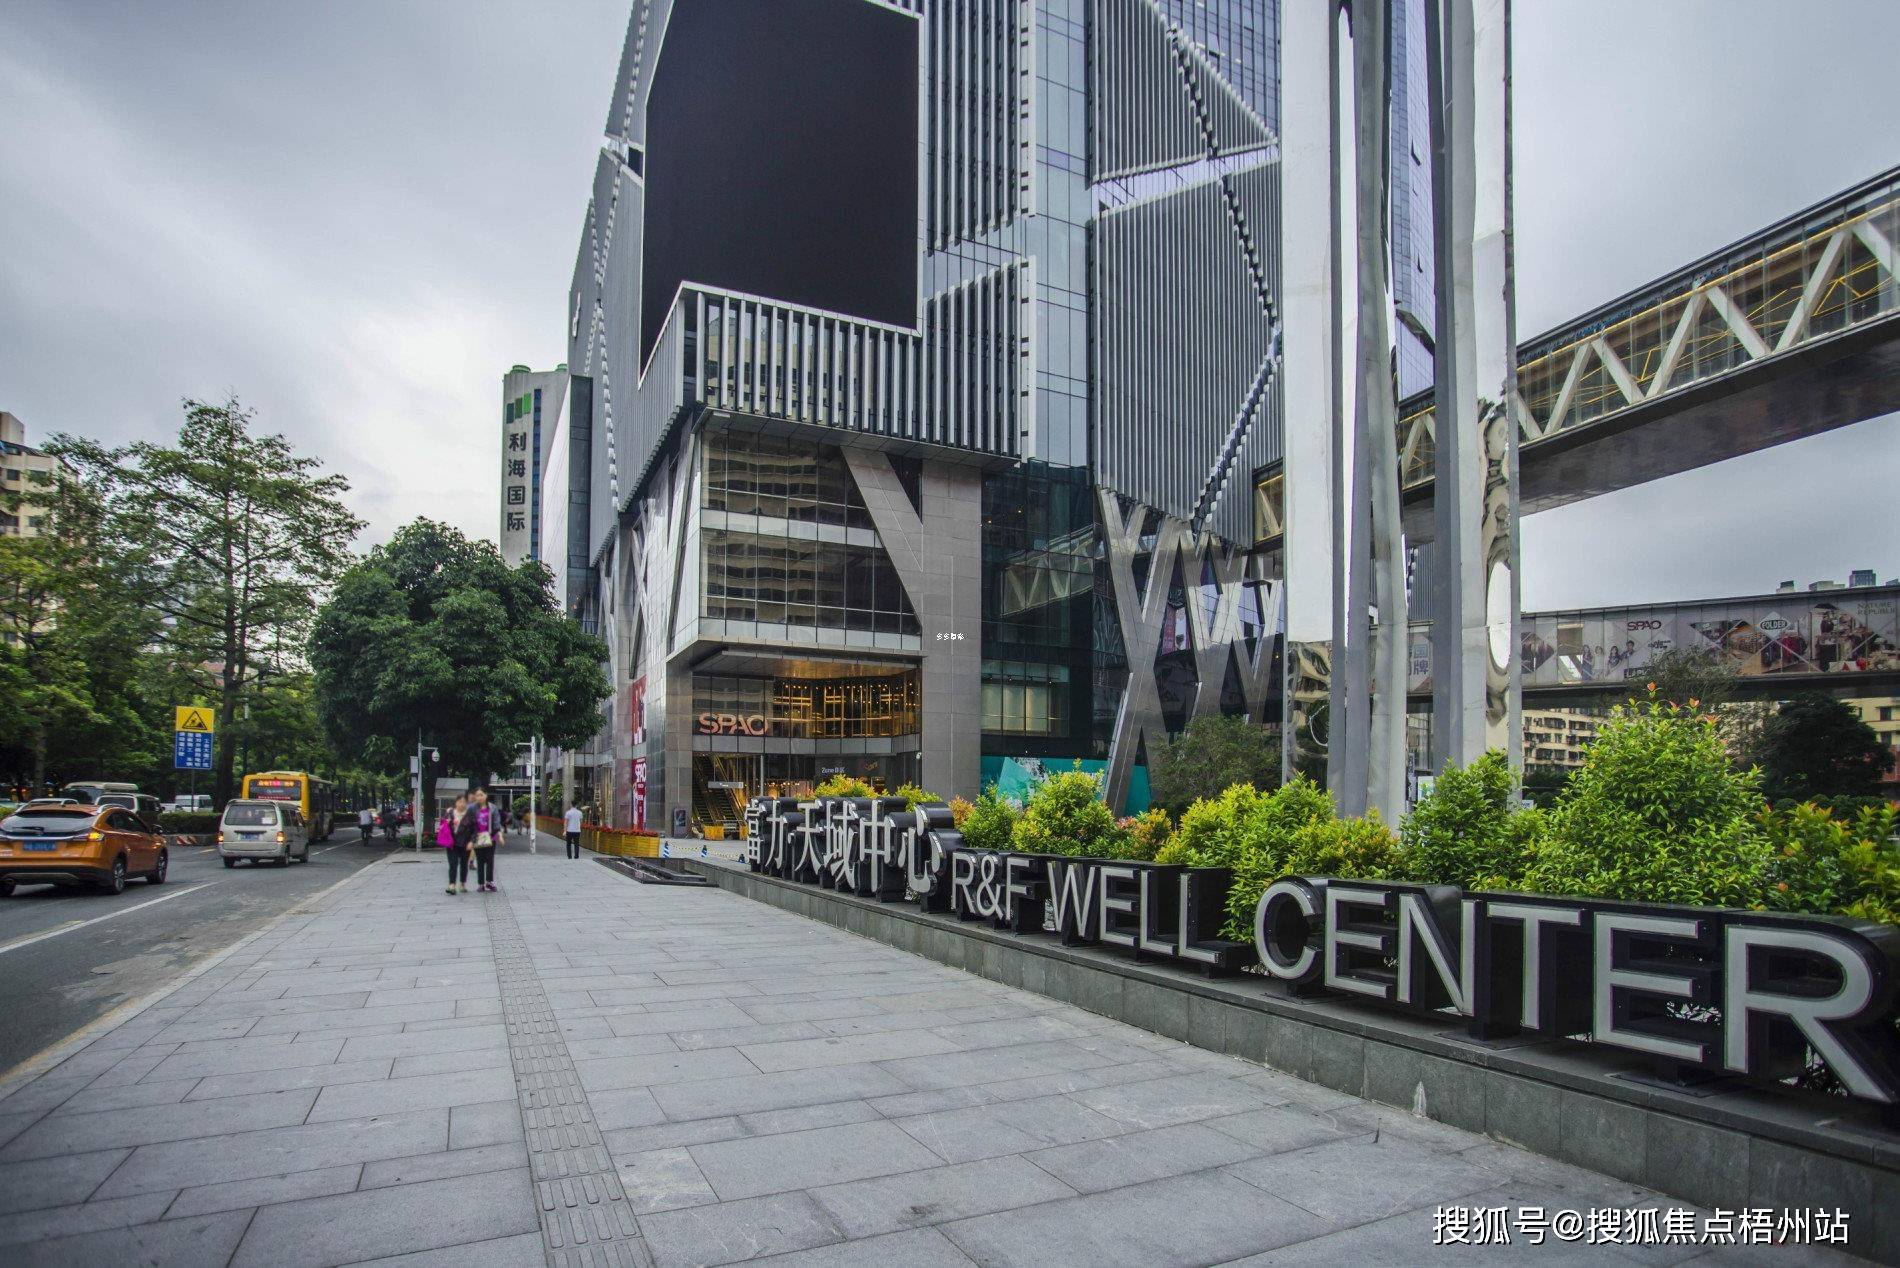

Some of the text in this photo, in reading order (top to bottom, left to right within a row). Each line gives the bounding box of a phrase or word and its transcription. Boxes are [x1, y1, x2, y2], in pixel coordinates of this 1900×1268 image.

[506, 432, 527, 531] 利海国际
[1627, 620, 1662, 631] SPAO
[951, 852, 1896, 1103] R&F WELL CENTER
